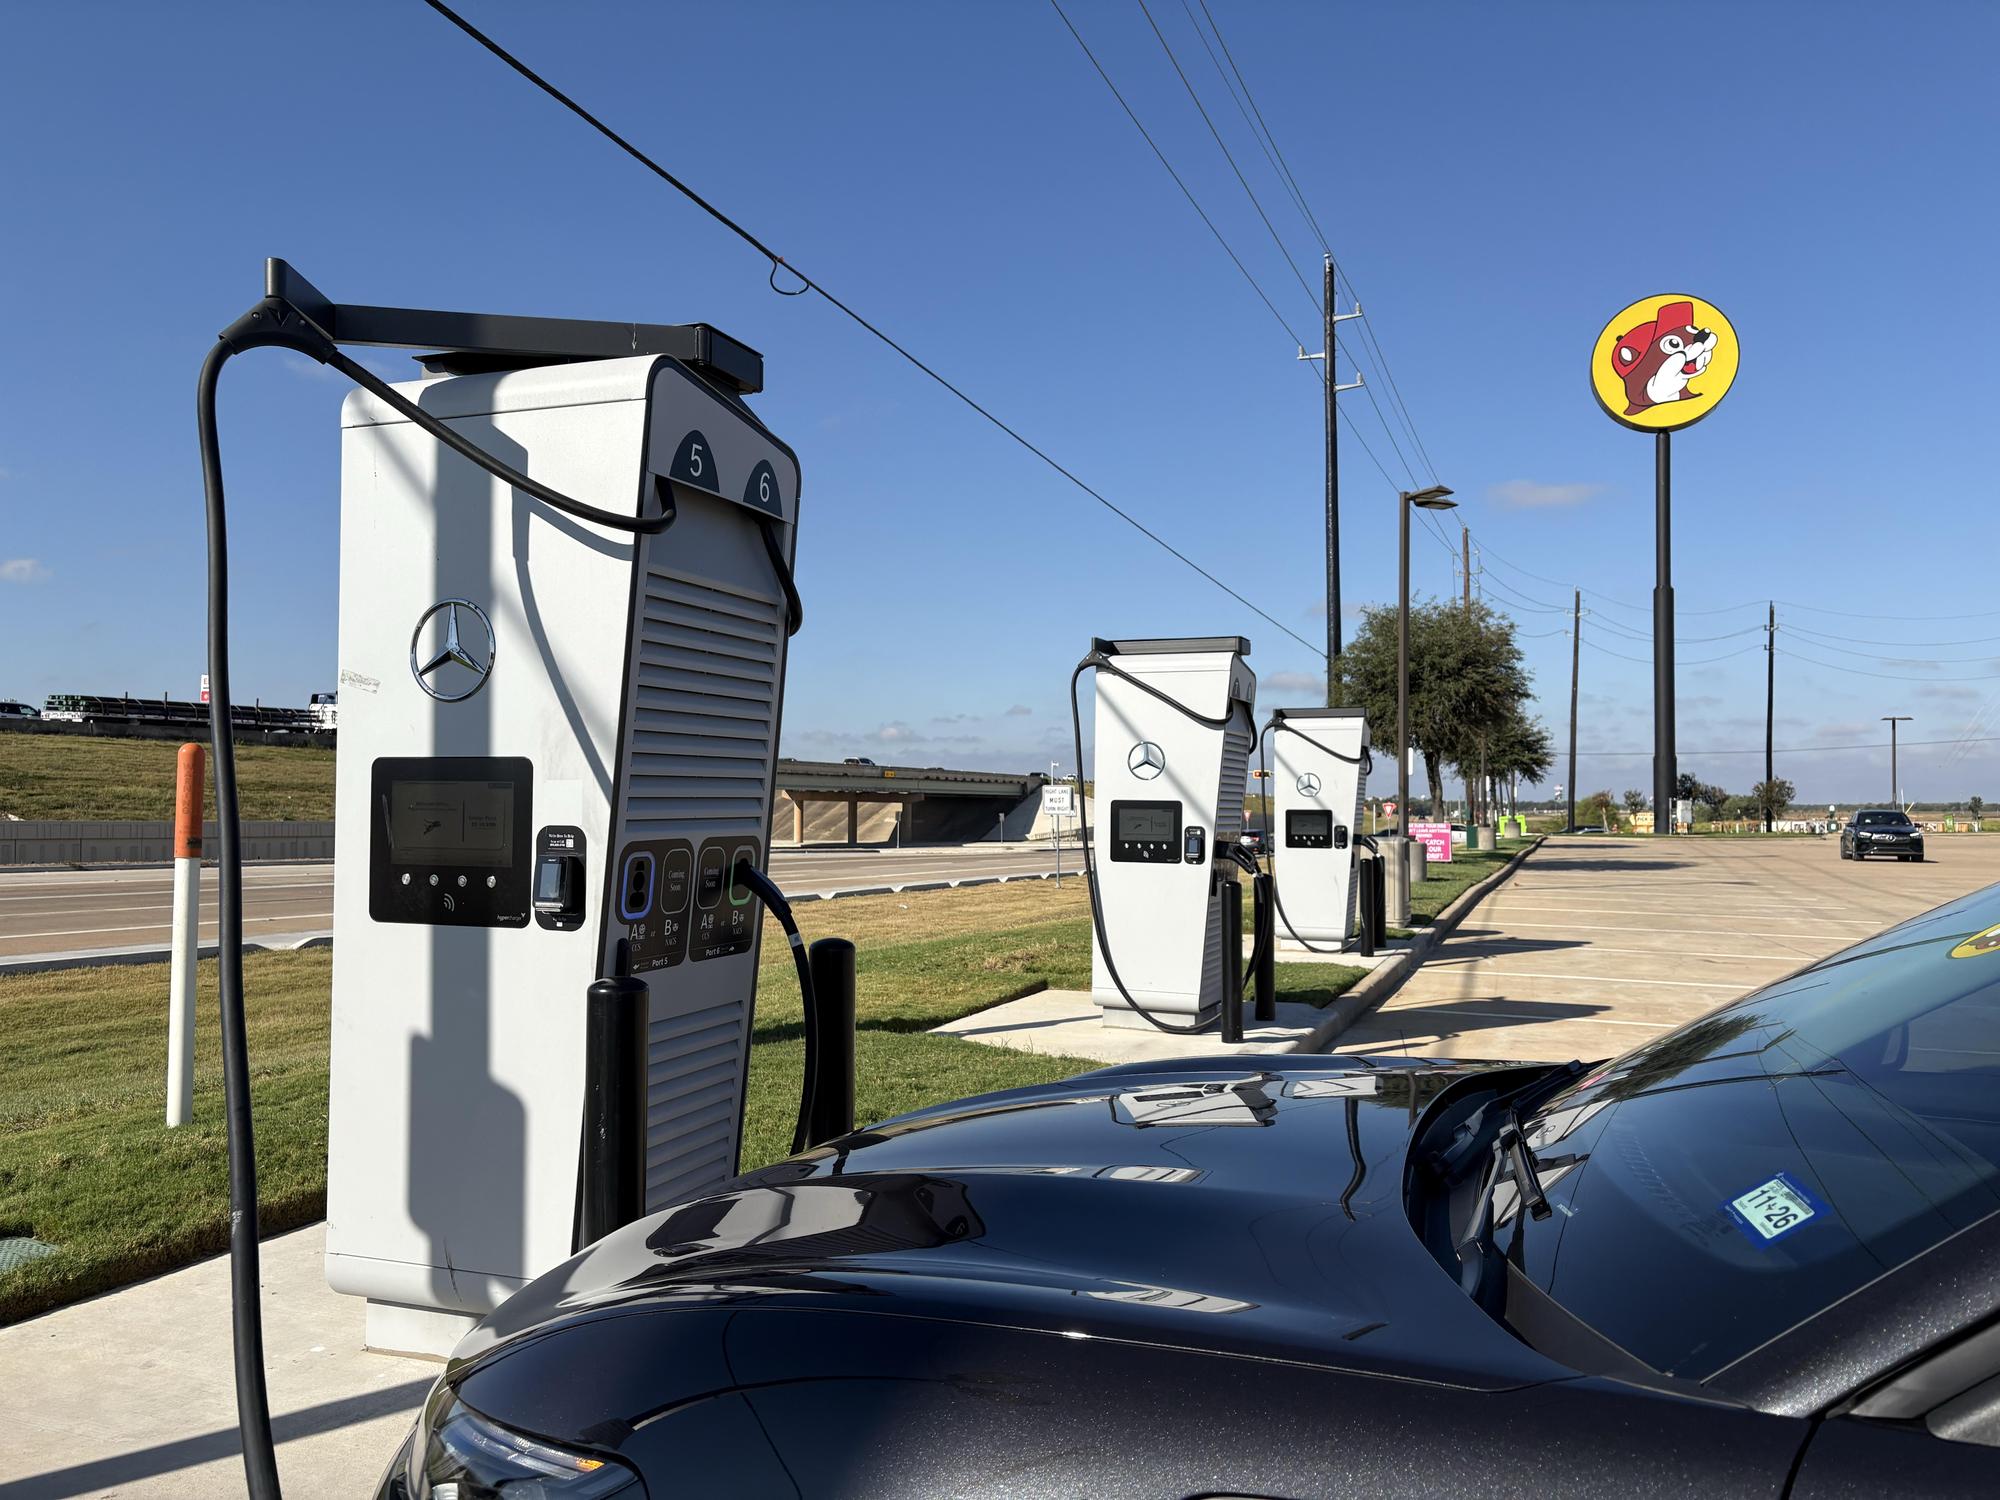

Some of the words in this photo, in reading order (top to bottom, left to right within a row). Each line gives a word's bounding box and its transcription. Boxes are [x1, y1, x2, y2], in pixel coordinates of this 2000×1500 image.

[690, 443, 703, 477] 5
[760, 472, 770, 503] 6
[668, 870, 685, 880] Coming
[704, 867, 720, 876] Coming
[670, 883, 681, 891] Soon
[705, 879, 716, 888] Soon
[700, 914, 708, 930] A
[732, 910, 739, 926] B
[630, 924, 638, 941] A
[664, 919, 672, 936] B
[732, 926, 743, 935] NACS
[701, 932, 710, 941] CCS
[665, 937, 677, 946] NACS
[632, 943, 642, 952] CCS
[705, 947, 716, 957] Port
[716, 946, 720, 954] 6
[652, 958, 664, 968] Port
[664, 957, 669, 966] 5
